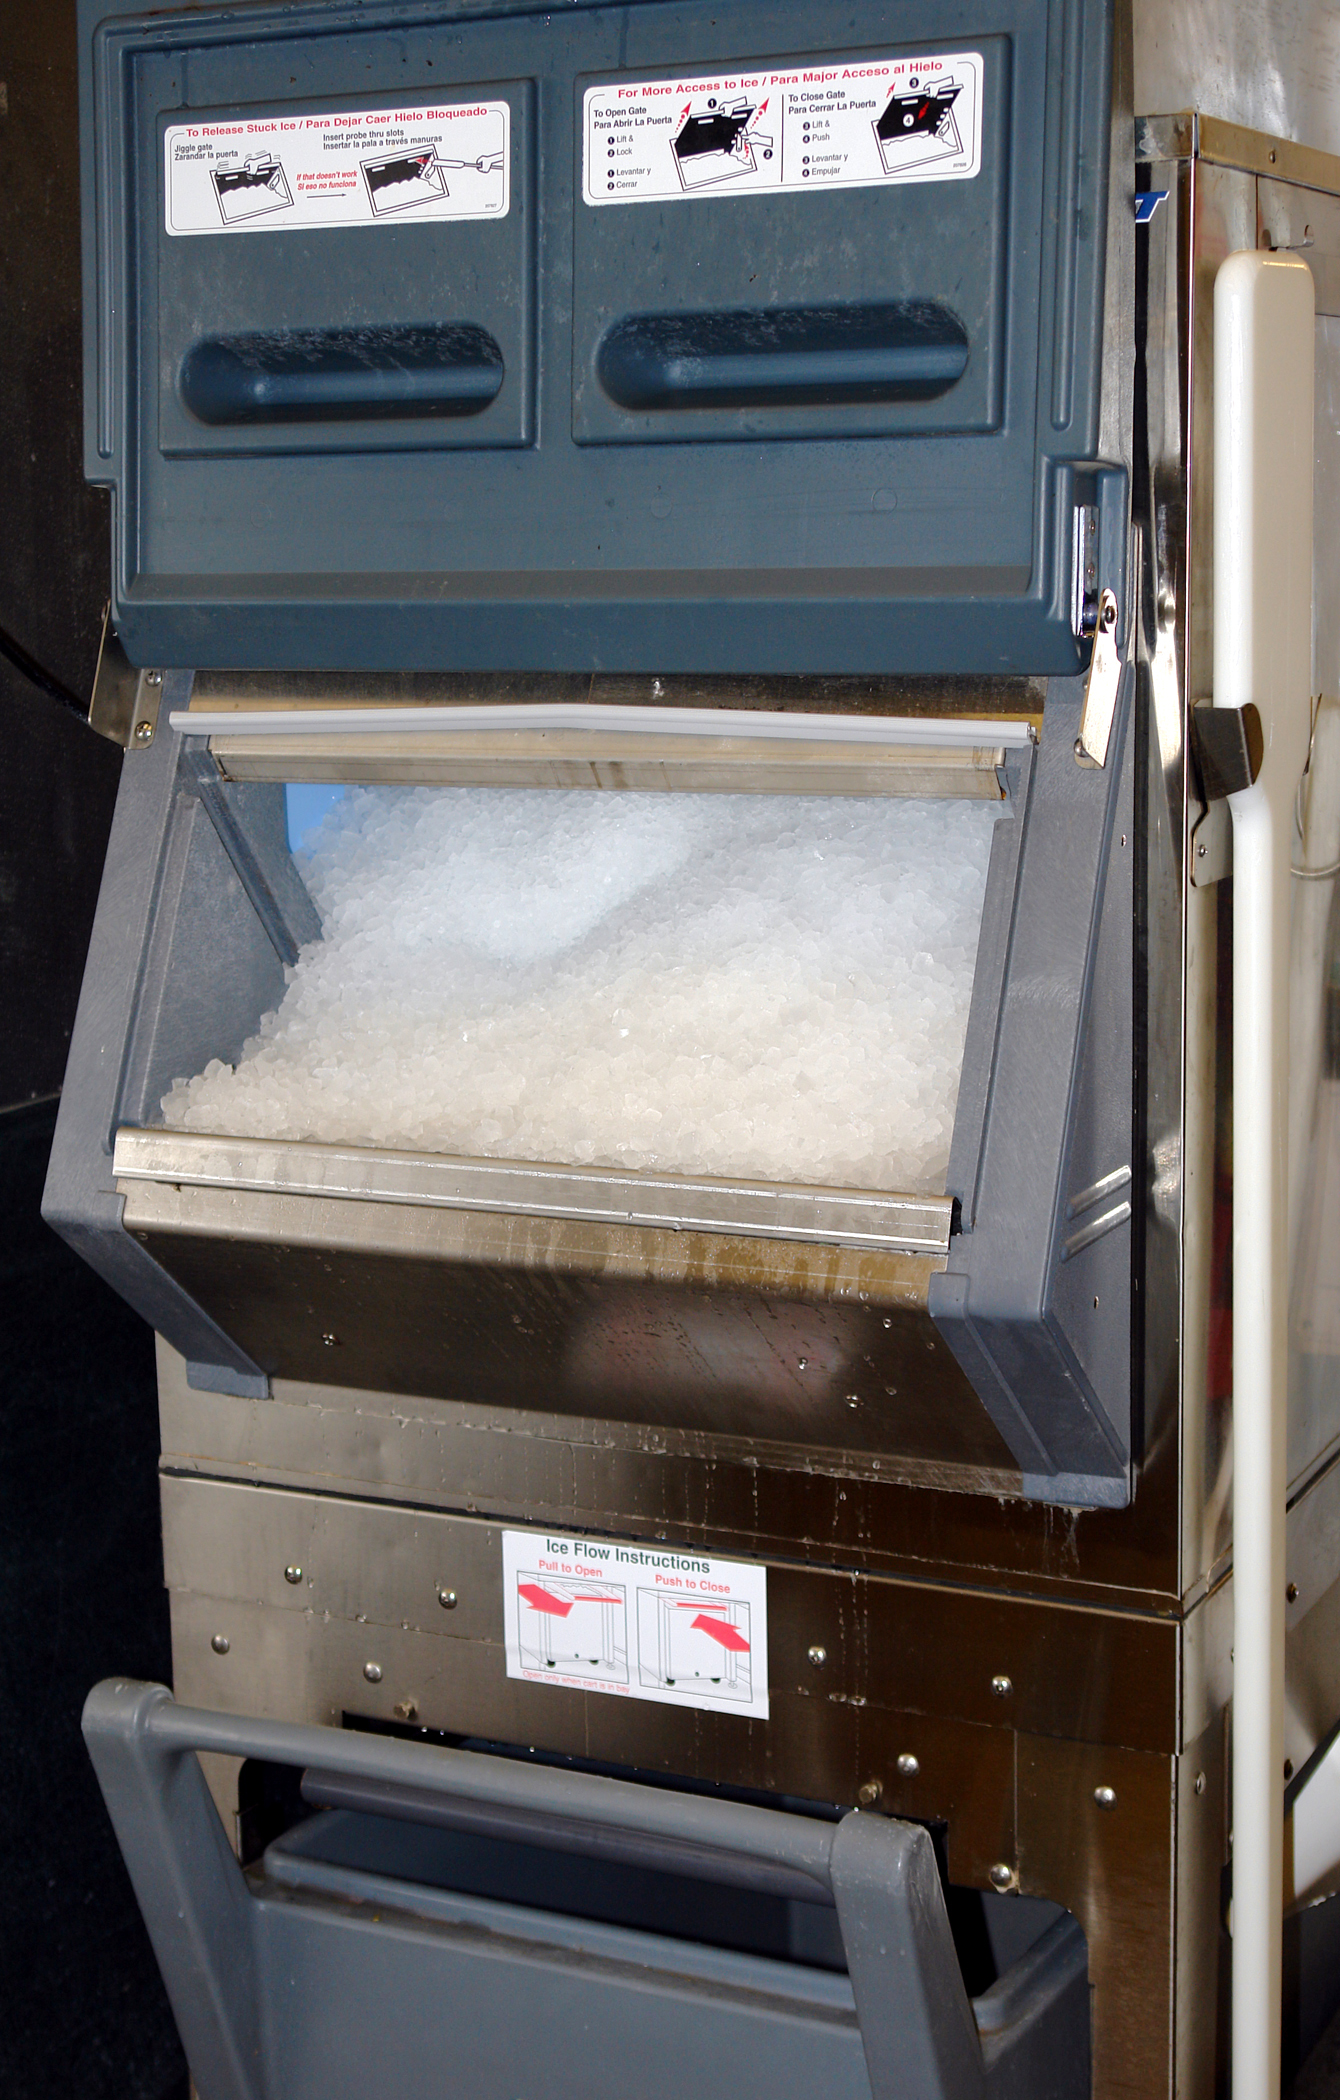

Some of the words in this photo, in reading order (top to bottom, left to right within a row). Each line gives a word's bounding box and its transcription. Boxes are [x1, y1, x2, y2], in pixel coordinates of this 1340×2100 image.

[618, 89, 638, 98] For
[642, 86, 672, 96] More
[676, 83, 720, 93] Access
[724, 81, 736, 89] to
[740, 78, 758, 88] Ice
[770, 75, 798, 86] Para
[803, 71, 838, 83] Major
[842, 68, 889, 78] Acceso
[894, 64, 905, 73] al
[910, 62, 943, 72] Hielo
[789, 94, 798, 102] To
[801, 92, 824, 102] Close
[826, 91, 845, 100] Gate
[605, 108, 626, 118] Open
[629, 107, 646, 116] Gate
[789, 106, 806, 114] Para
[809, 104, 834, 113] Cerrar
[837, 102, 847, 110] La
[850, 100, 876, 109] Puerta
[186, 129, 198, 137] To
[202, 125, 243, 136] Release
[247, 122, 277, 133] Stuck
[281, 122, 296, 130] Ice
[306, 120, 330, 128] Para
[334, 117, 362, 127] Dejar
[366, 116, 391, 124] Caer
[395, 113, 422, 122] Hielo
[427, 108, 487, 119] Bloqueado
[594, 121, 611, 129] Para
[613, 119, 632, 128] Abrir
[647, 116, 672, 125] Puerta
[323, 133, 344, 141] Insert
[346, 132, 367, 142] probe
[323, 141, 351, 149] Insertar
[362, 140, 377, 149] pala
[410, 135, 442, 144] manuras
[175, 152, 205, 161] Zarandar
[216, 150, 238, 159] puerta
[812, 154, 841, 163] Levantar
[316, 172, 341, 180] doesn't
[616, 168, 645, 176] Levantar
[811, 167, 840, 176] Empujar
[547, 1539, 568, 1554] Ice
[575, 1542, 610, 1560] Flow
[616, 1548, 710, 1574] Instructions
[539, 1560, 558, 1571] Pull
[562, 1564, 572, 1573] to
[575, 1565, 602, 1577] Open
[655, 1574, 682, 1587] Push
[686, 1579, 696, 1589] to
[700, 1581, 730, 1593] Close
[523, 1670, 543, 1679] Open
[544, 1675, 558, 1684] only
